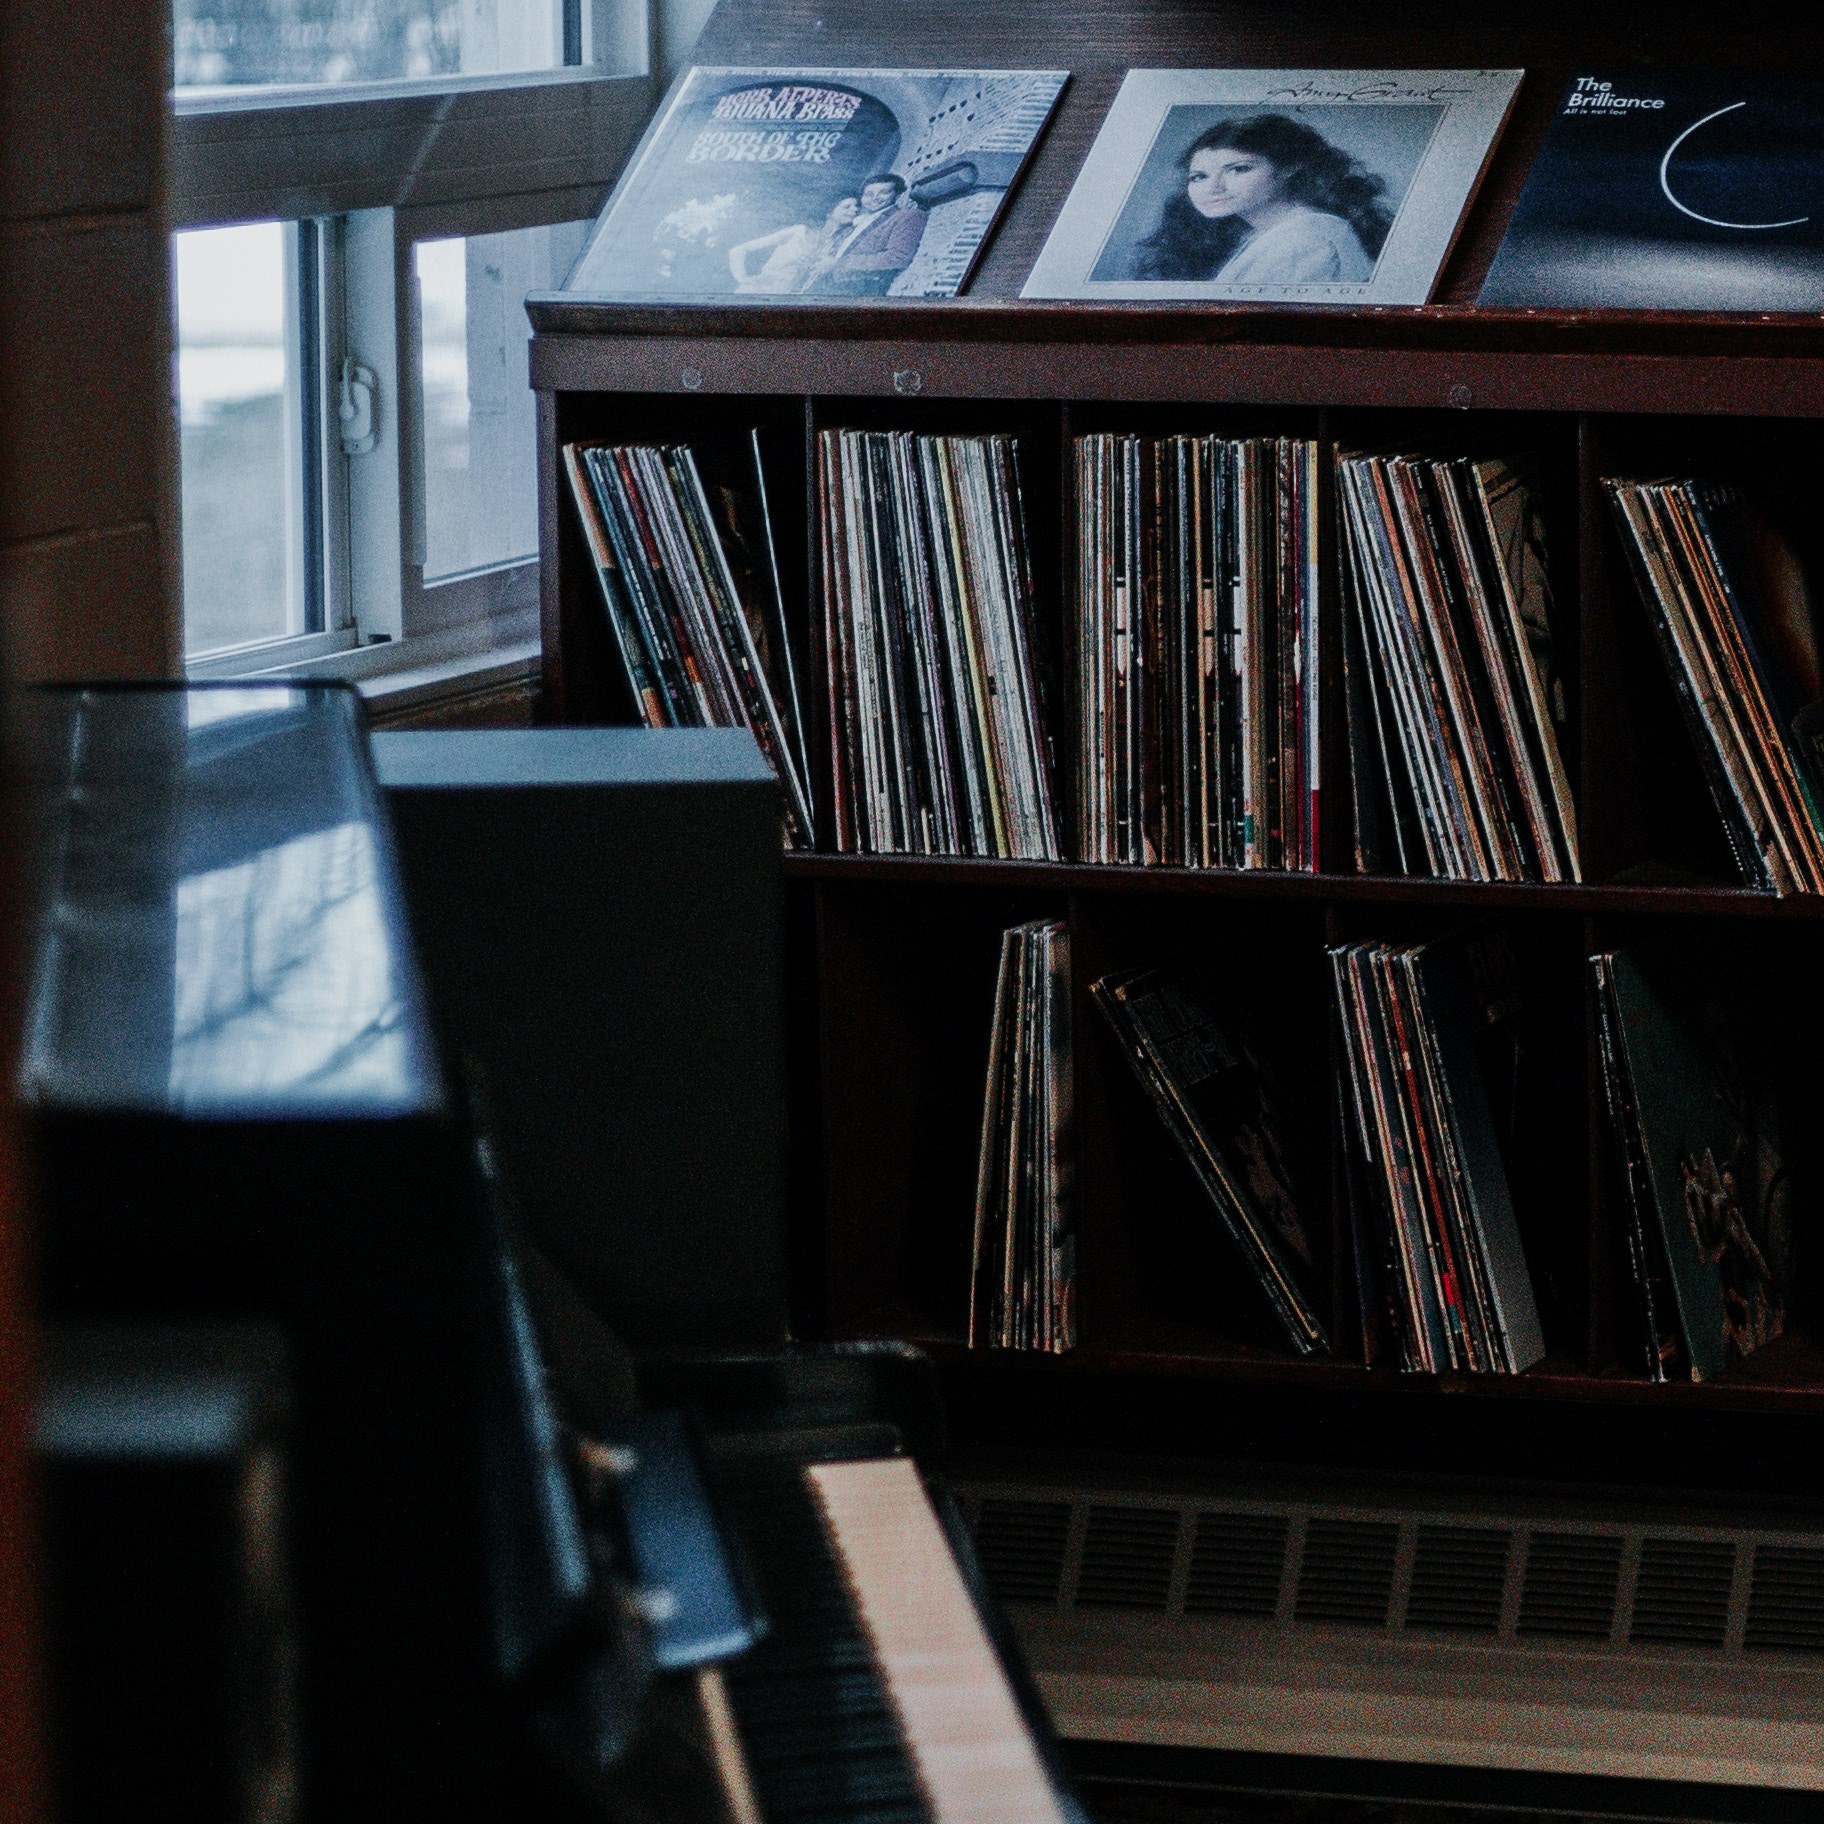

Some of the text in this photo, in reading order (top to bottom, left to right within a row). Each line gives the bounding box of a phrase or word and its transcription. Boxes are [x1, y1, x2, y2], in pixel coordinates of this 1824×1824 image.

[1577, 77, 1613, 92] The
[1568, 93, 1666, 109] Brilliance
[697, 130, 765, 148] SOUTH
[767, 130, 791, 147] OF
[686, 144, 832, 164] BORDER
[1224, 286, 1366, 295] AGE TO AGE
